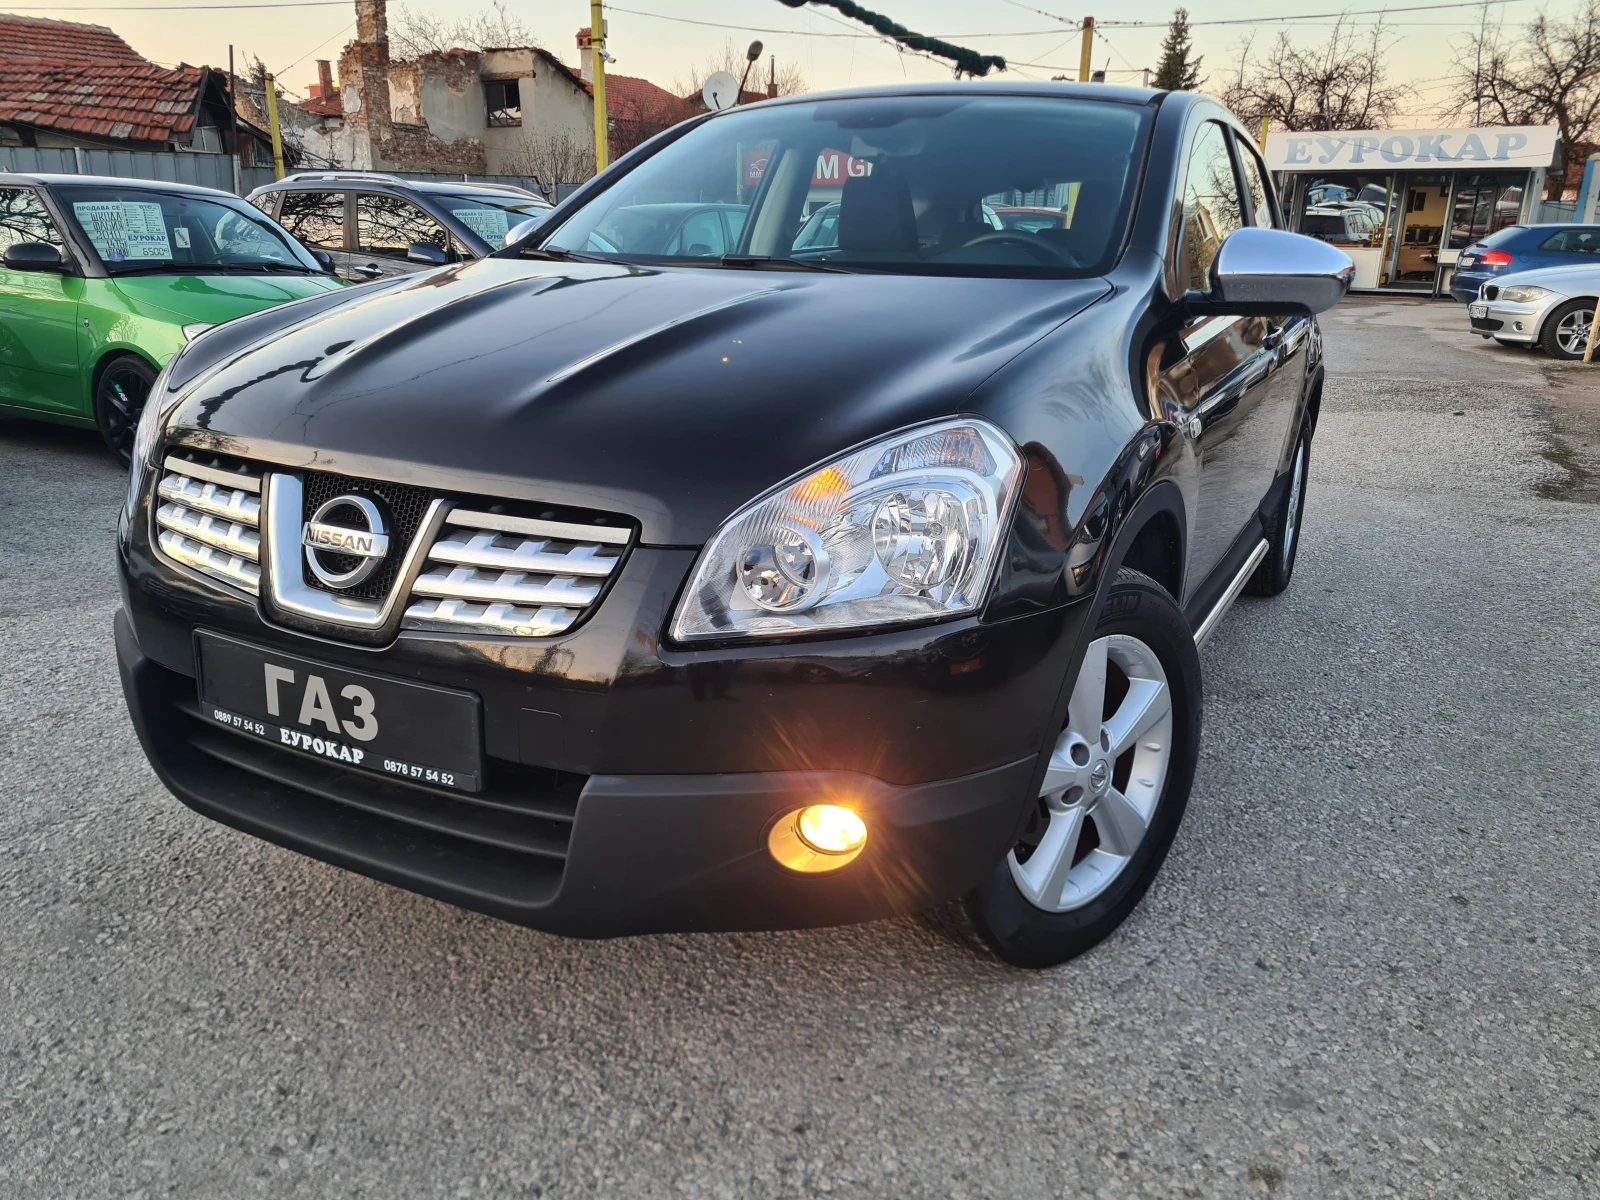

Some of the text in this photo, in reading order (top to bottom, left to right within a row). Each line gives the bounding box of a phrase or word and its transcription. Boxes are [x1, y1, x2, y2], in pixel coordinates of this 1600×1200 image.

[1283, 132, 1528, 165] ЕУРОКАР
[305, 526, 373, 552] NISSAN
[264, 662, 379, 742] ГАЗ
[214, 709, 266, 736] 0889 57 54 52
[280, 727, 365, 765] ЕУРОКАР
[384, 759, 455, 786] 0878 57 54 52
